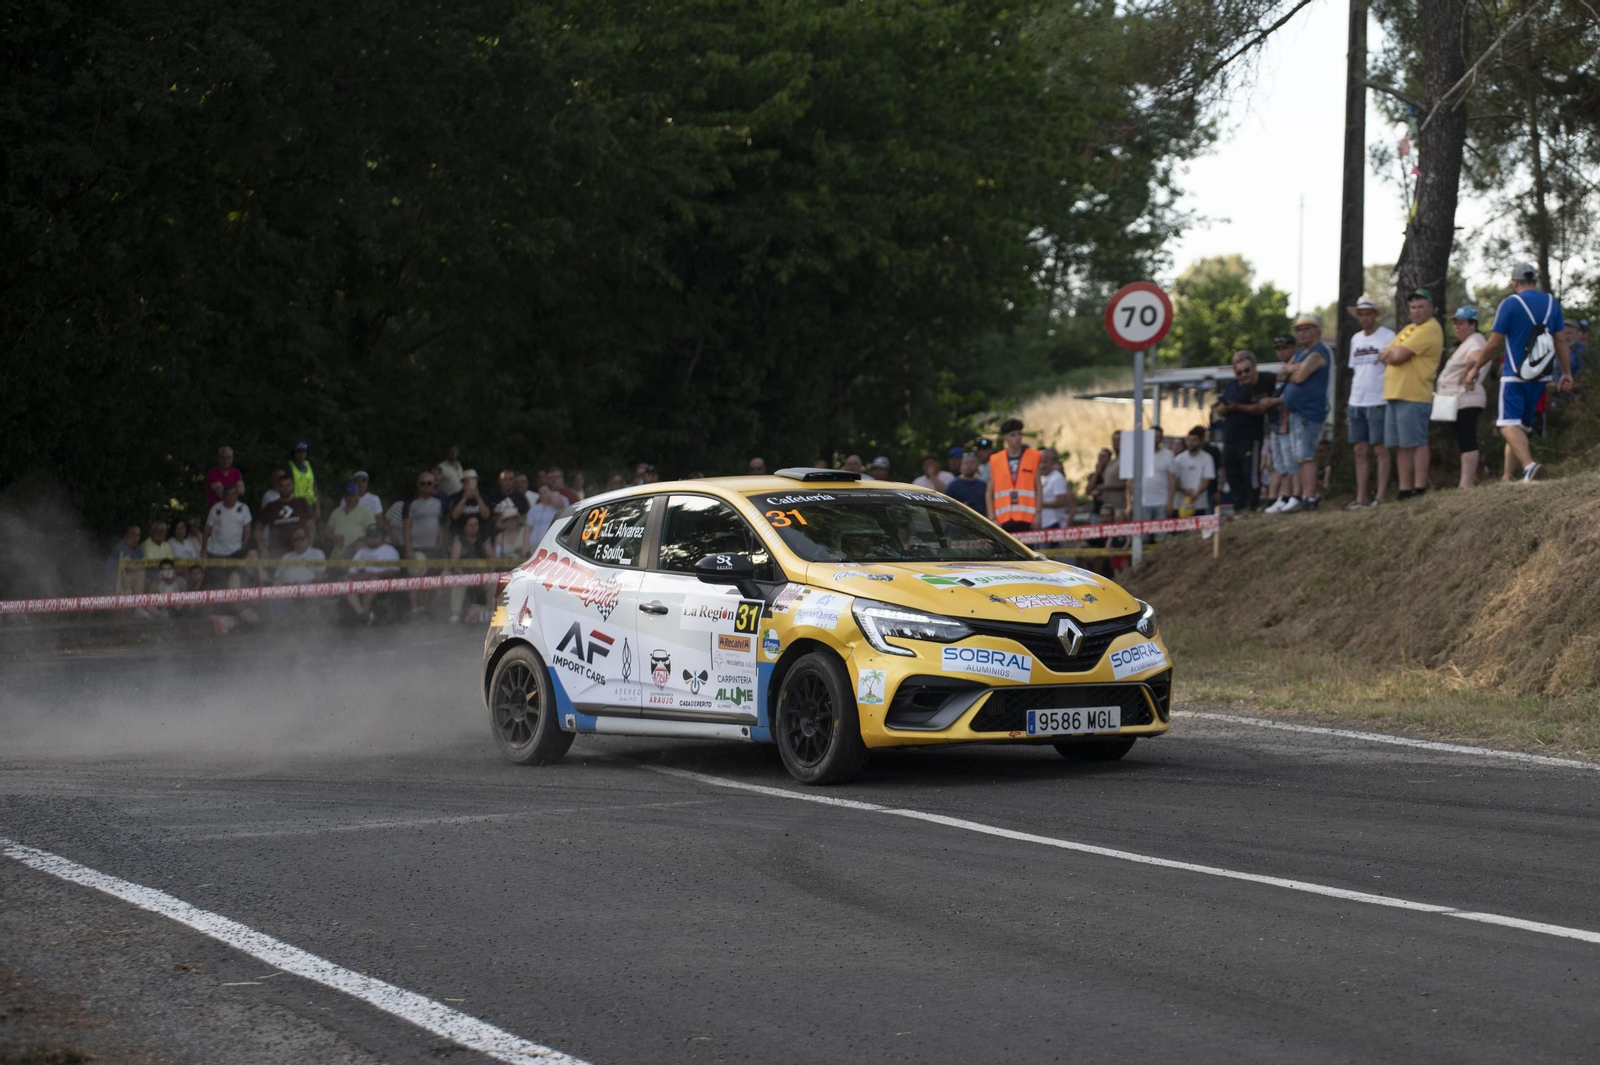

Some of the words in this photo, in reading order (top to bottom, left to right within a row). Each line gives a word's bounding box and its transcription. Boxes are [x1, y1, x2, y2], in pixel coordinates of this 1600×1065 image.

[1121, 305, 1157, 328] 70
[582, 508, 609, 541] 31
[765, 508, 808, 528] 31
[594, 544, 603, 559] F.
[602, 544, 624, 560] Souto
[60, 599, 77, 611] ZONA
[80, 596, 116, 610] PROHIBIDO
[150, 593, 168, 605] ZONA
[171, 591, 207, 605] PROHIBIDO
[242, 588, 259, 600] ZONA
[262, 585, 297, 599] PROHIBIDO
[332, 582, 350, 595] ZONA
[353, 579, 389, 593] PROHIBIDO
[423, 576, 442, 588] ZONA
[444, 574, 481, 587] PROHIBIDO
[582, 578, 622, 607] Sport
[683, 604, 697, 616] La
[699, 604, 735, 622] Región
[736, 603, 758, 631] 31
[556, 620, 615, 665] AF
[944, 647, 1031, 671] SOBRAL
[1111, 642, 1161, 668] SOBRAL
[552, 654, 585, 675] IMPORT
[586, 668, 606, 685] CARS
[966, 664, 1010, 677] ALUMINIOS
[614, 688, 641, 696] ATENEO
[649, 696, 674, 704] ARAUJO
[679, 700, 712, 708] CASADEPEPITO
[1039, 712, 1081, 731] 9586
[1087, 710, 1117, 729] MGL
